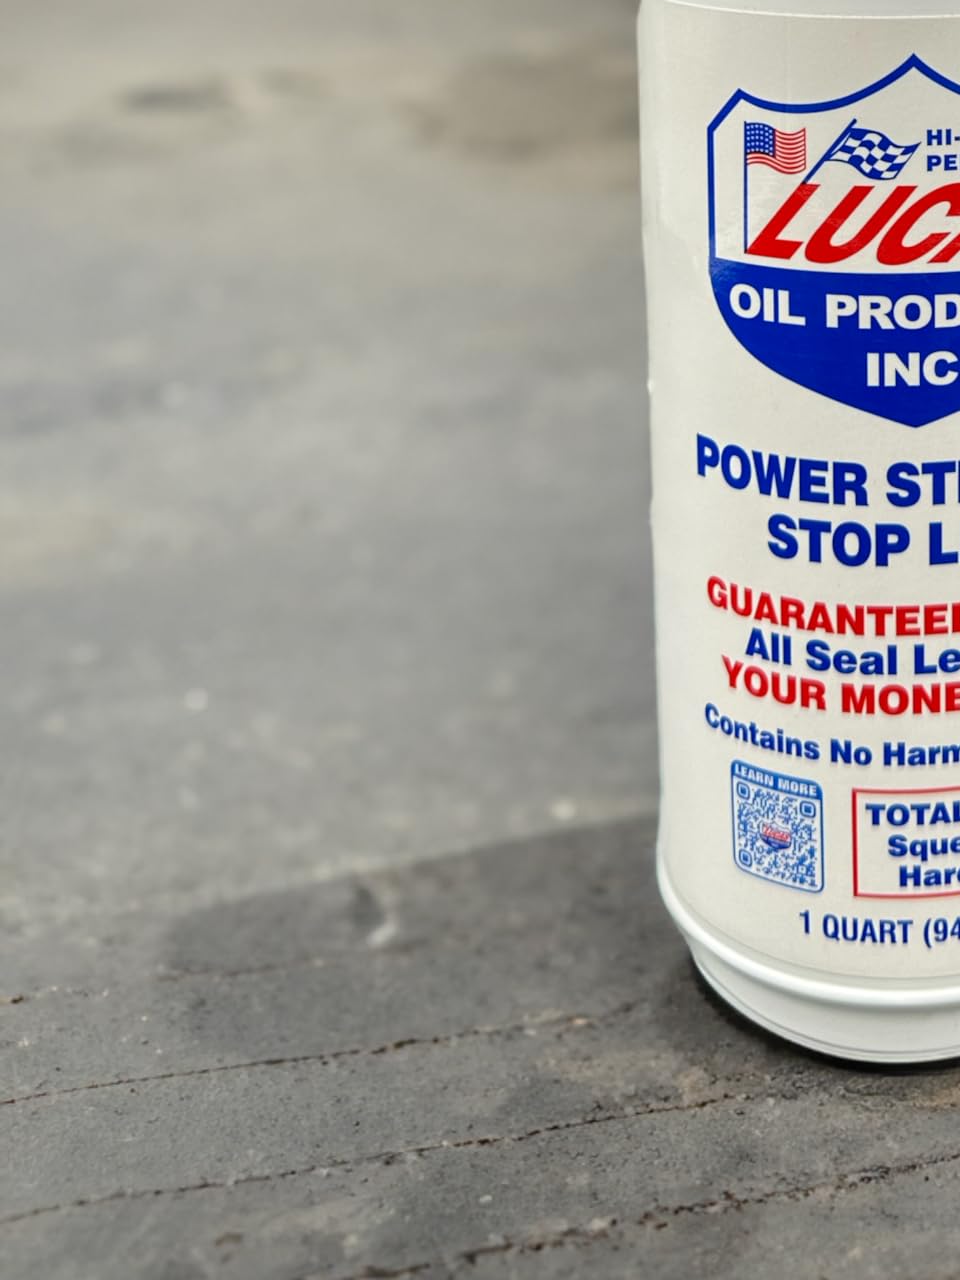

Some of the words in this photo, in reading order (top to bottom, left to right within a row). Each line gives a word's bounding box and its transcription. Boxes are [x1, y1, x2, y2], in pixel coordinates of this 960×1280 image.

[926, 128, 960, 147] HI-
[729, 282, 807, 327] OIL
[696, 432, 868, 506] POWER
[768, 513, 911, 567] STOP
[746, 627, 792, 667] All
[806, 639, 898, 676] Seal
[721, 655, 827, 712] YOUR
[704, 703, 820, 761] Contains
[831, 738, 873, 766] No
[734, 762, 774, 787] LEARN
[777, 778, 818, 797] MORE
[799, 910, 812, 935] 1
[822, 914, 913, 944] QUART
